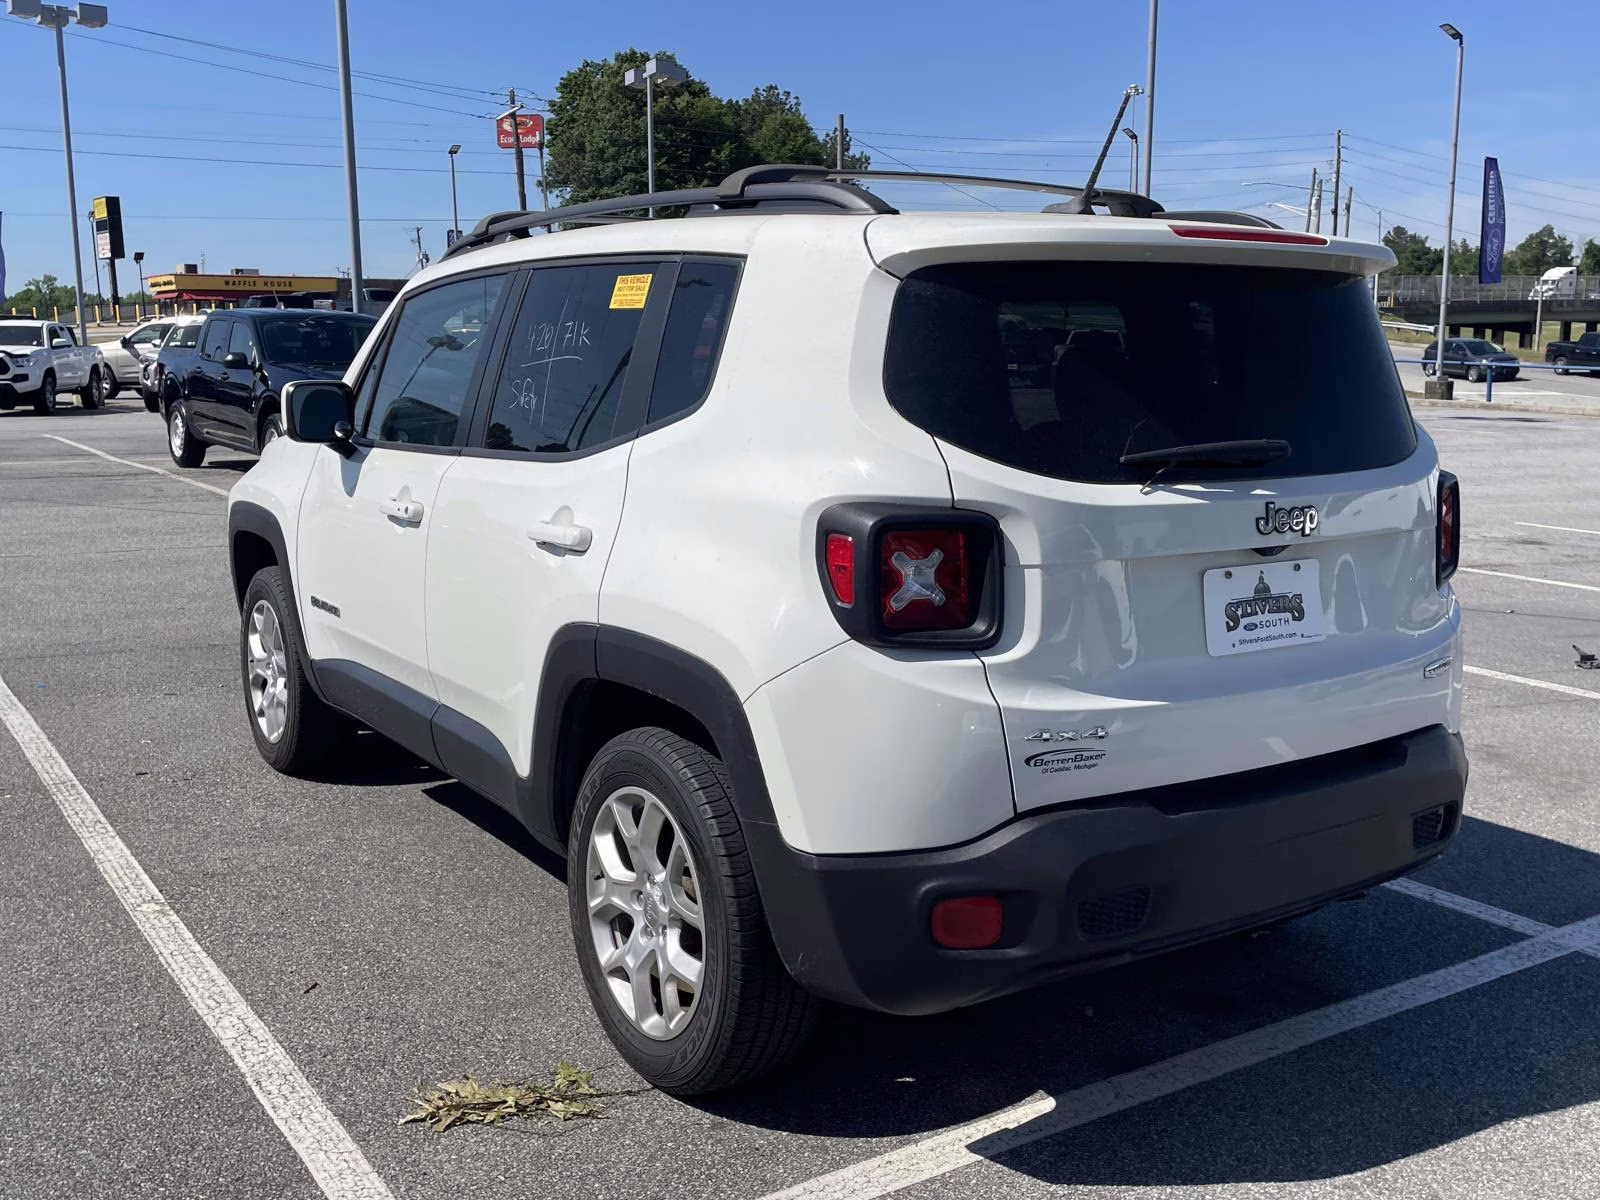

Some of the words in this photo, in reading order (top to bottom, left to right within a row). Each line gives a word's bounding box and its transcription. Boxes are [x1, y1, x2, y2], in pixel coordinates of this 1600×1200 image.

[263, 280, 293, 288] HOUSE
[630, 275, 650, 284] VEHICLE
[1255, 502, 1319, 537] Jeep
[1225, 593, 1305, 633] STIVERS
[1258, 617, 1290, 629] SOUTH
[1049, 765, 1072, 773] Cadillac
[1073, 763, 1099, 771] Michigan
